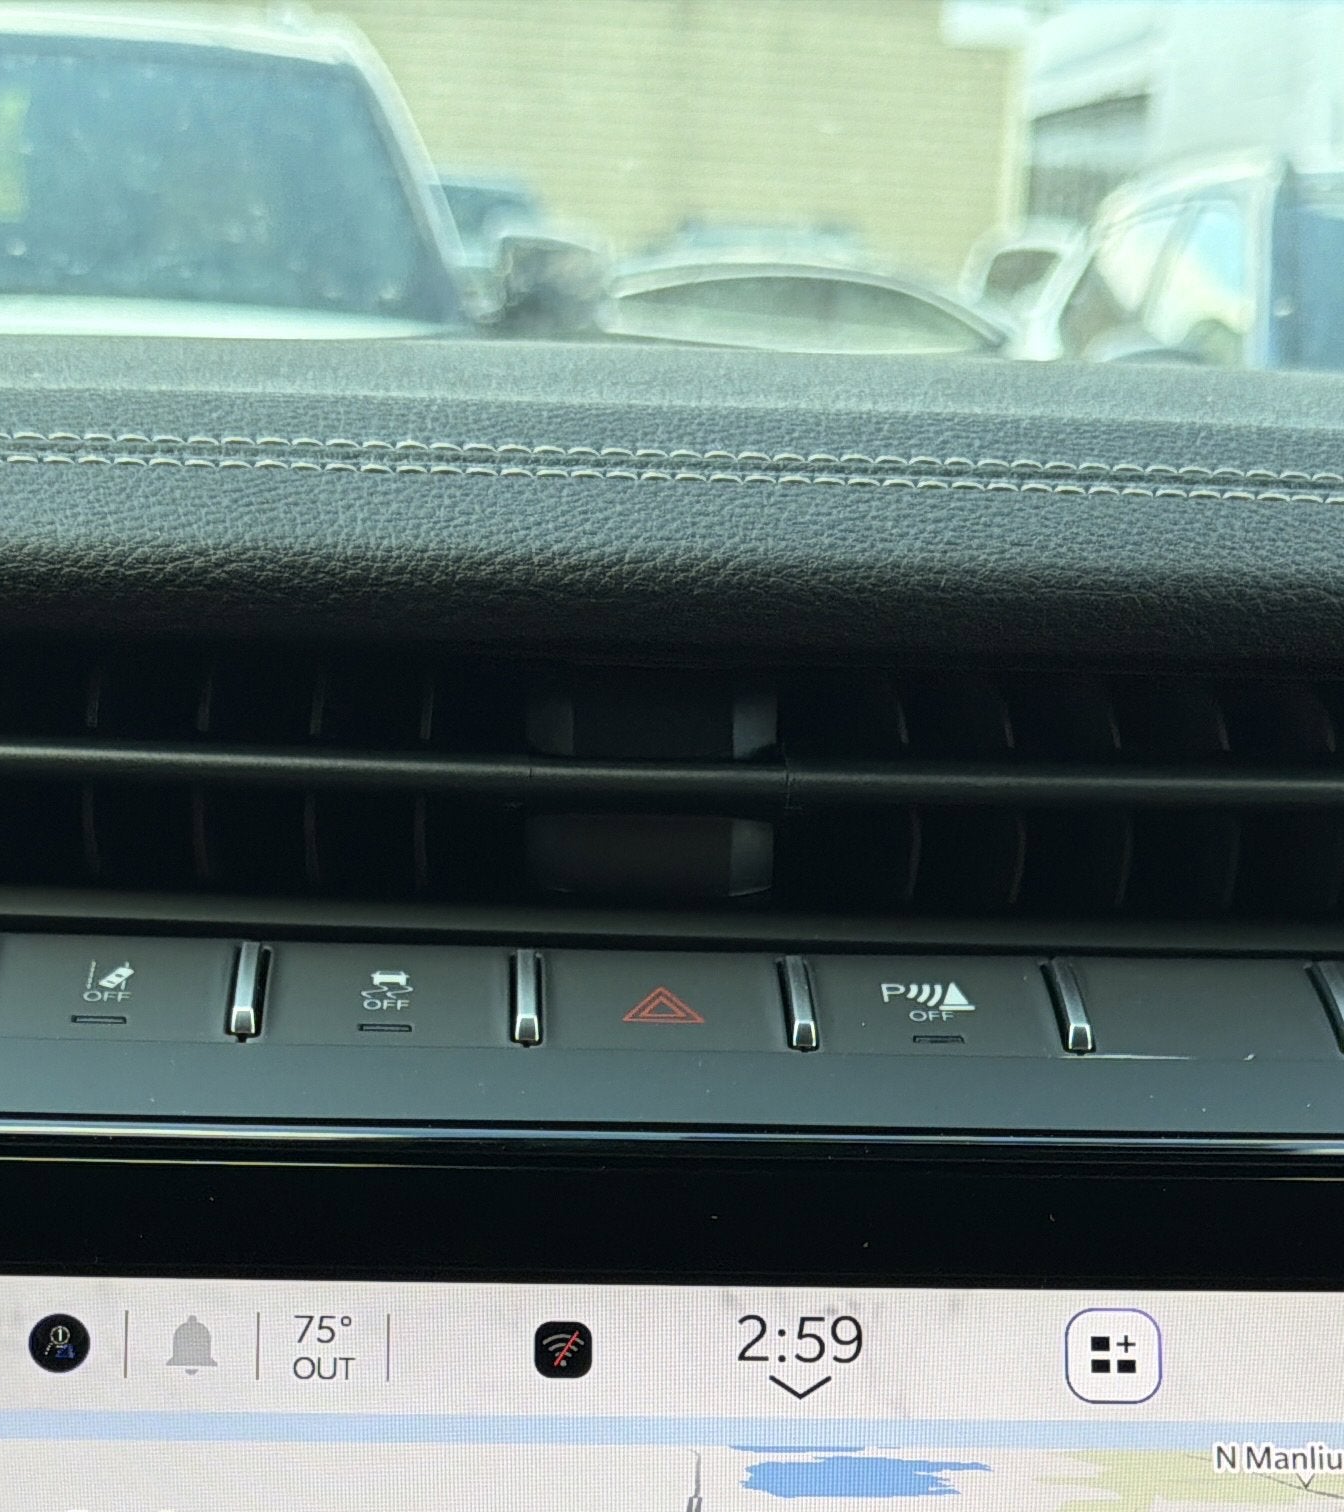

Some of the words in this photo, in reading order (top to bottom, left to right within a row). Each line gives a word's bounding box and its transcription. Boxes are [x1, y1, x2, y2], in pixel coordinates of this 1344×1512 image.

[83, 989, 131, 1002] OFF
[362, 998, 411, 1011] OFF
[909, 1010, 954, 1022] OFF
[295, 1316, 353, 1345] 75°
[737, 1315, 863, 1363] 2:59
[292, 1356, 356, 1382] OUT
[1215, 1447, 1238, 1470] N
